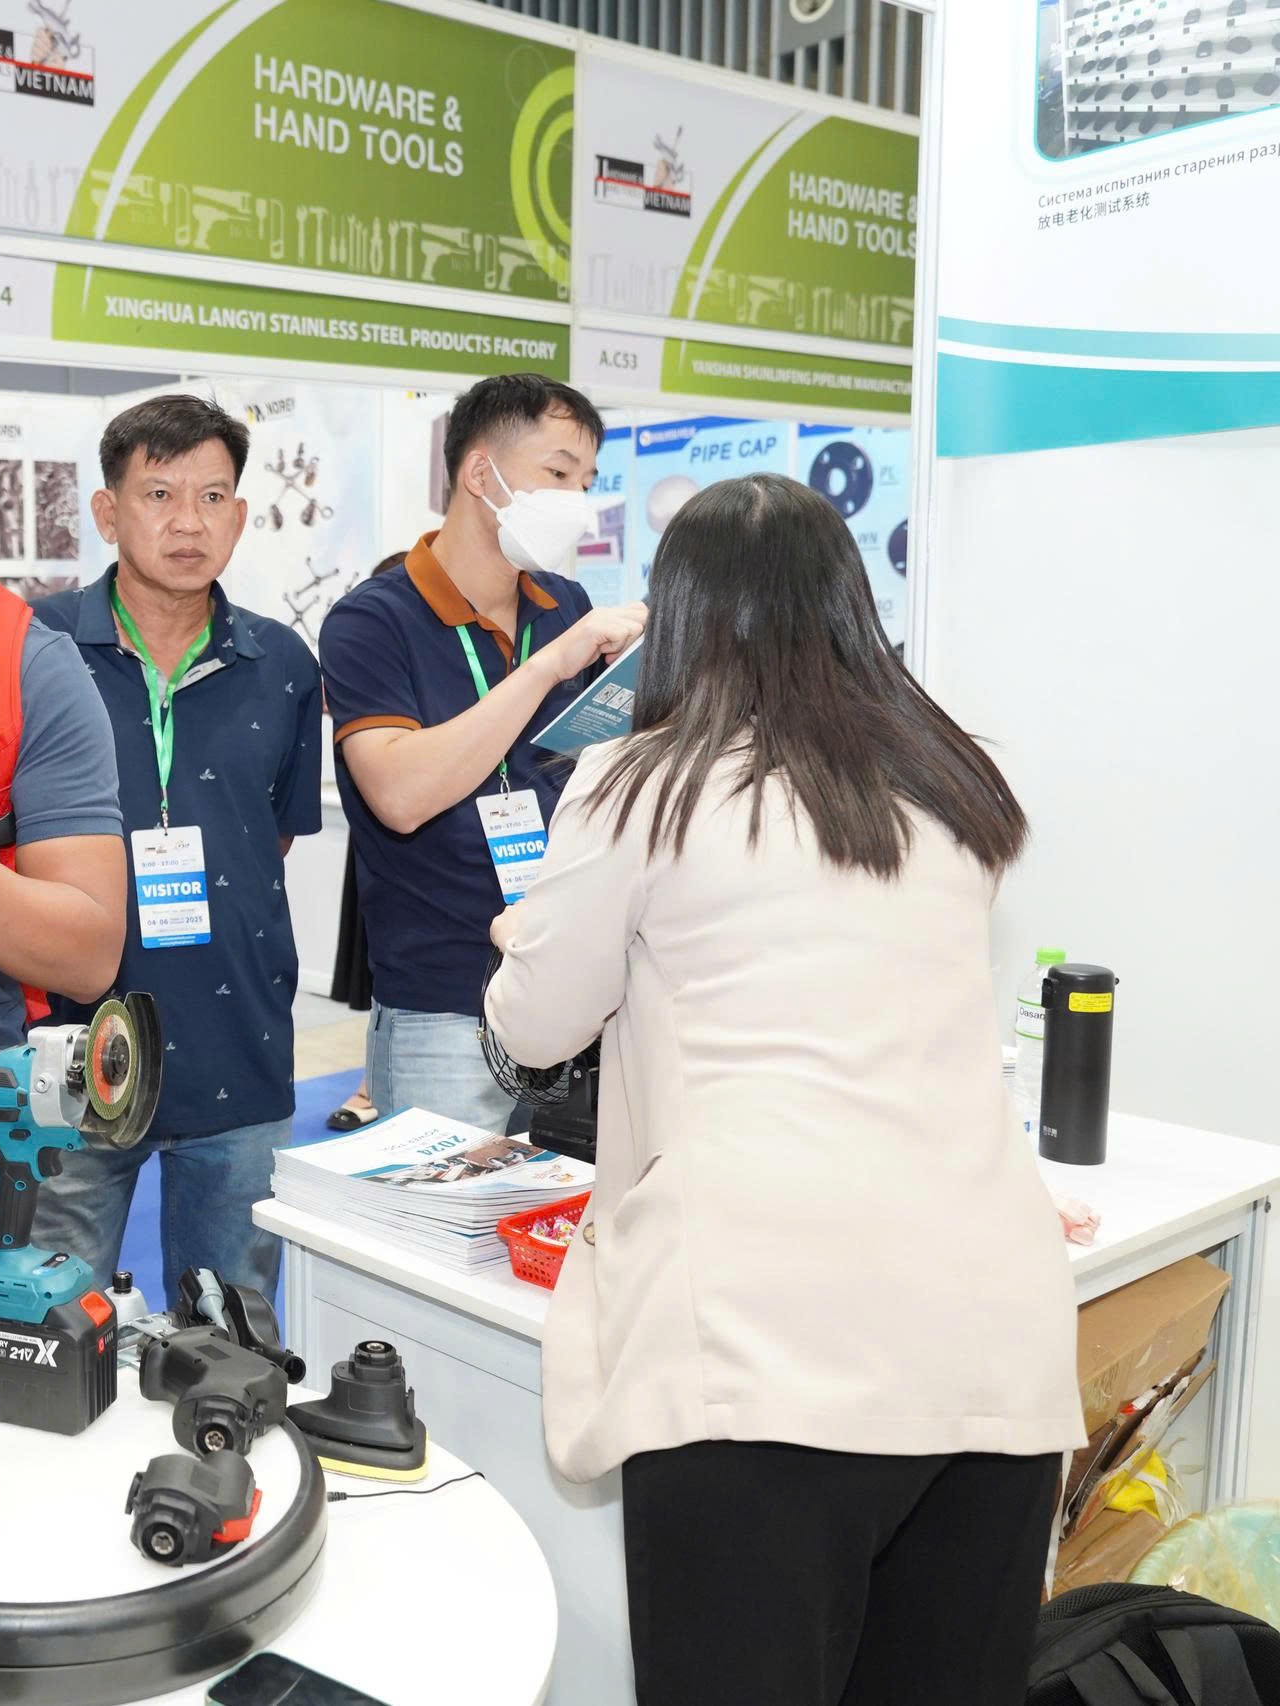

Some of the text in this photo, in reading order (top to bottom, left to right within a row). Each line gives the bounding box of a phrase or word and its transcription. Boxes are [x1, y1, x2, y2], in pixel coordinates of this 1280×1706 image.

[15, 67, 94, 100] VIETNAM
[254, 53, 462, 132] HARDWARE &
[254, 103, 463, 177] HAND TOOLS
[788, 170, 904, 220] HARDWARE
[1038, 141, 1280, 209] Система испытания старения раз
[788, 208, 917, 259] HAND TOOLS
[1037, 191, 1151, 231] 放电老化测试系统
[104, 295, 558, 360] XINGHUA LANGYI STAINLESS STEEL PRODUCTS FACTORY
[599, 350, 638, 370] A.C53
[689, 435, 778, 464] PIPE CAP
[494, 839, 546, 858] VISITOR
[142, 881, 203, 898] VISITOR
